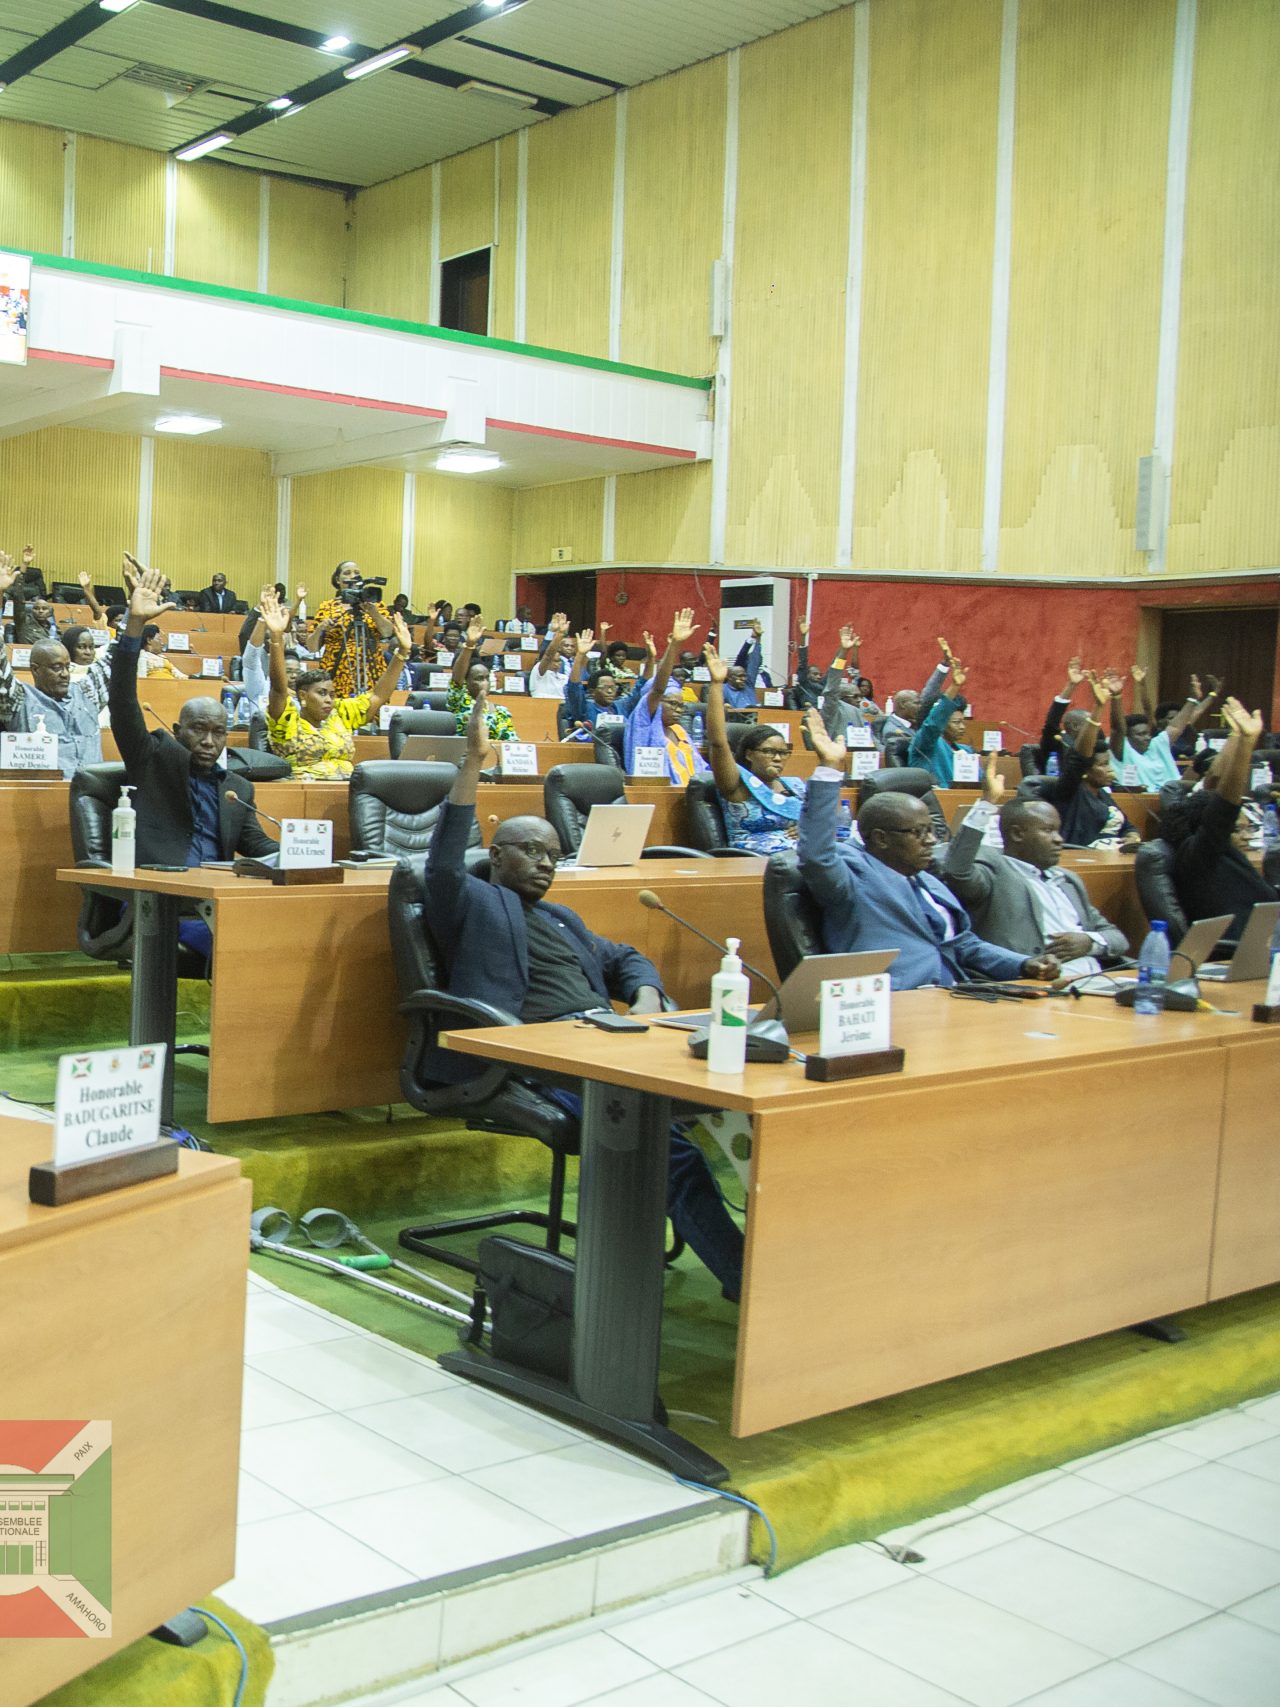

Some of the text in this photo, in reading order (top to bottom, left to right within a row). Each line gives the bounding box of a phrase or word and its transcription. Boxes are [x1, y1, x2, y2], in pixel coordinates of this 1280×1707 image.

[838, 1010, 877, 1027] BAHATI
[79, 1079, 144, 1104] Honorable
[64, 1099, 156, 1128] BADUGARITSE
[85, 1124, 134, 1149] Claude
